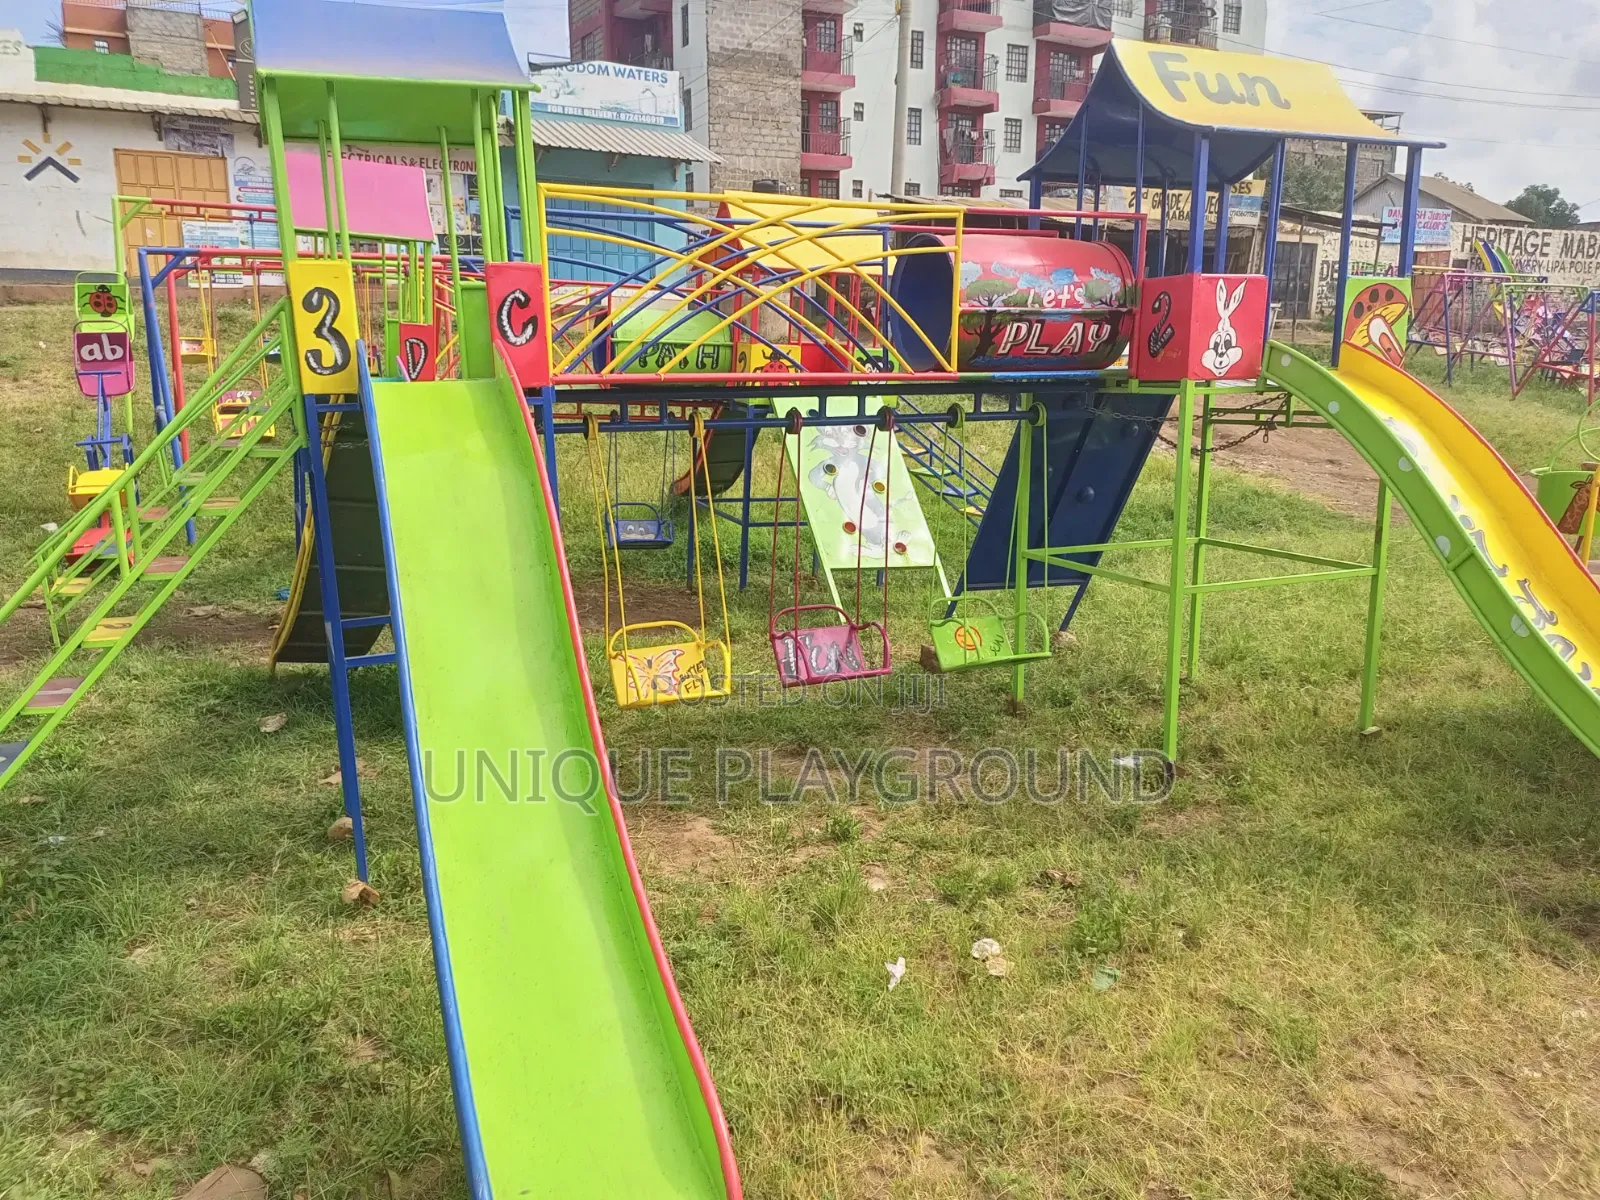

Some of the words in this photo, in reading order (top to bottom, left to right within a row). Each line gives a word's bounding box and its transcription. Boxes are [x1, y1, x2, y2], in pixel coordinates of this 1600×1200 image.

[613, 66, 669, 84] WATERS
[1148, 51, 1292, 110] Fun
[302, 286, 352, 376] 3
[496, 289, 538, 347] C
[996, 318, 1112, 357] PLAY
[1147, 290, 1176, 359] 2
[80, 333, 124, 361] ab
[405, 338, 429, 381] D
